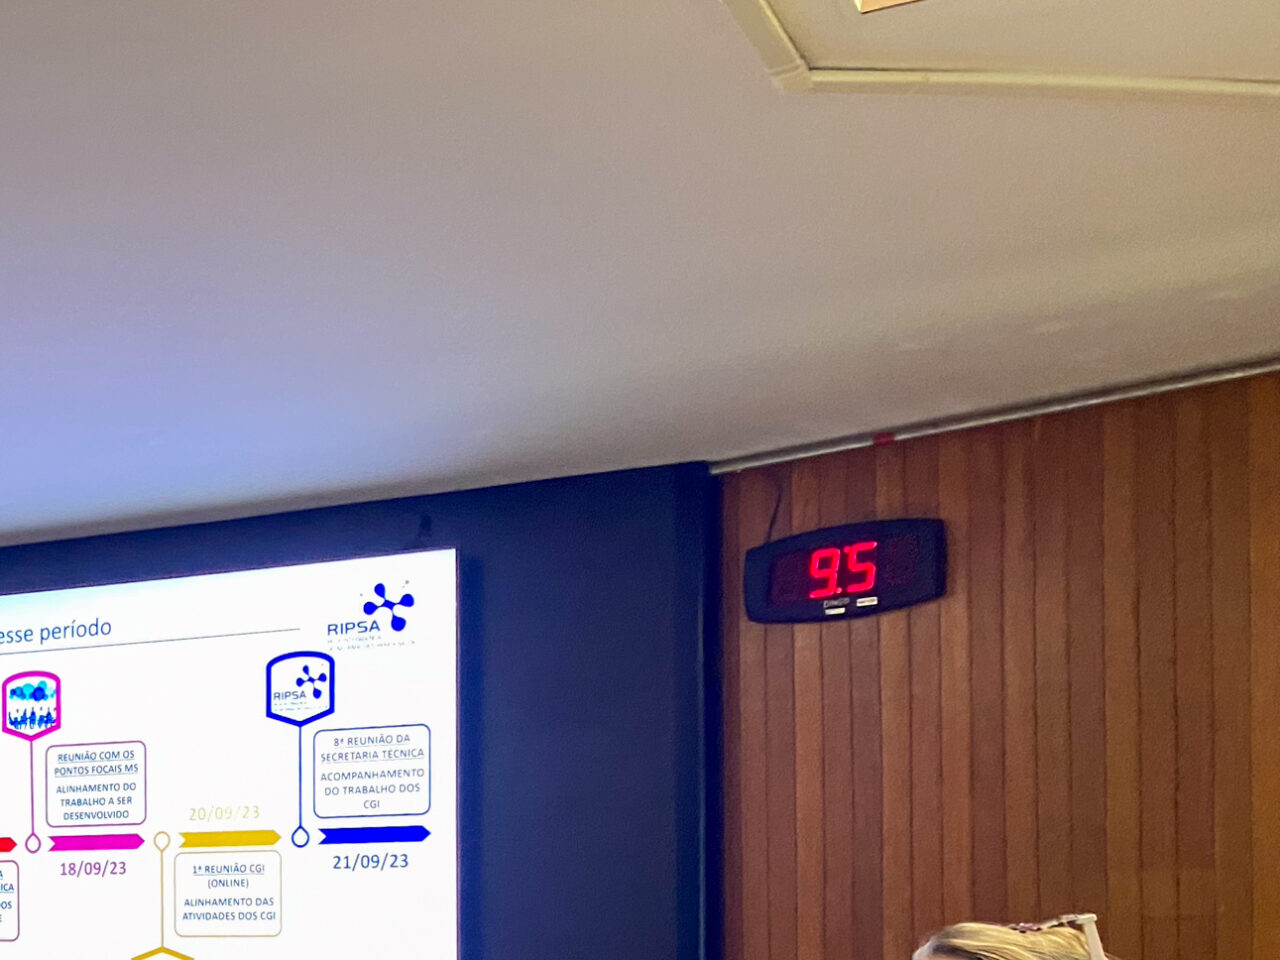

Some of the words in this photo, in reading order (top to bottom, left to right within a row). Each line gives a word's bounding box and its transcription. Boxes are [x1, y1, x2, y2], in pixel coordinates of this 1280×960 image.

[40, 618, 112, 644] período
[328, 619, 380, 636] RIPSA
[274, 690, 306, 700] RIPSA
[348, 734, 394, 746] REUNIÃO
[396, 734, 410, 744] DA
[58, 751, 96, 762] REUNIÃO
[99, 751, 120, 760] COM
[122, 750, 135, 759] OS
[320, 750, 378, 762] SECRETARIA
[54, 766, 90, 776] PONTOS
[92, 764, 122, 774] FOCAIS
[124, 764, 138, 773] MS
[320, 768, 425, 782] ACOMPANHAMENTO
[56, 783, 120, 794] ALINHAMENTO
[122, 782, 136, 792] DO
[324, 787, 340, 796] DO
[342, 784, 396, 795] TRABALHO
[399, 783, 420, 792] DOS
[60, 797, 106, 807] TRABALHO
[108, 797, 115, 806] A
[117, 796, 132, 806] SER
[363, 800, 380, 809] CGI
[63, 810, 130, 820] DESENVOLVIDO
[188, 805, 260, 823] 20/09/23
[204, 862, 247, 874] REUNIÃO
[250, 864, 265, 873] CGI
[332, 852, 409, 872] 21/09/23
[60, 860, 127, 878] 18/09/23
[208, 878, 249, 889] (ONLINE)
[184, 898, 252, 907] ALINHAMENTO
[256, 896, 274, 906] DAS
[182, 911, 236, 921] ATIVIDADES
[238, 911, 258, 920] DOS
[260, 911, 276, 920] CGI
